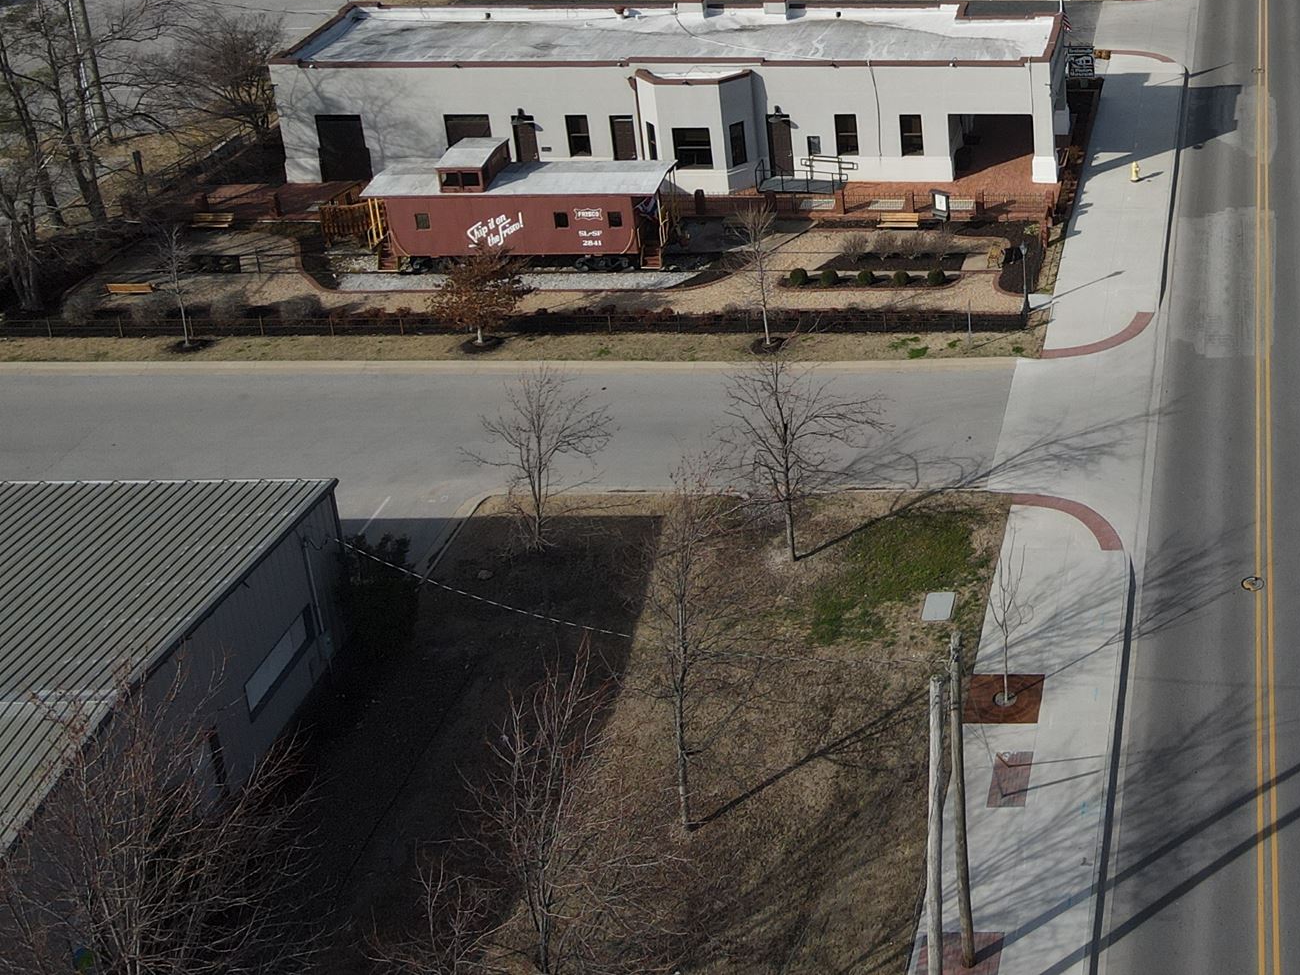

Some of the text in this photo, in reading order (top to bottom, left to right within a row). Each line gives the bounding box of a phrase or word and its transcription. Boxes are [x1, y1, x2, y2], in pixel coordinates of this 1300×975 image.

[467, 214, 507, 248] Ship it on
[487, 233, 499, 247] the
